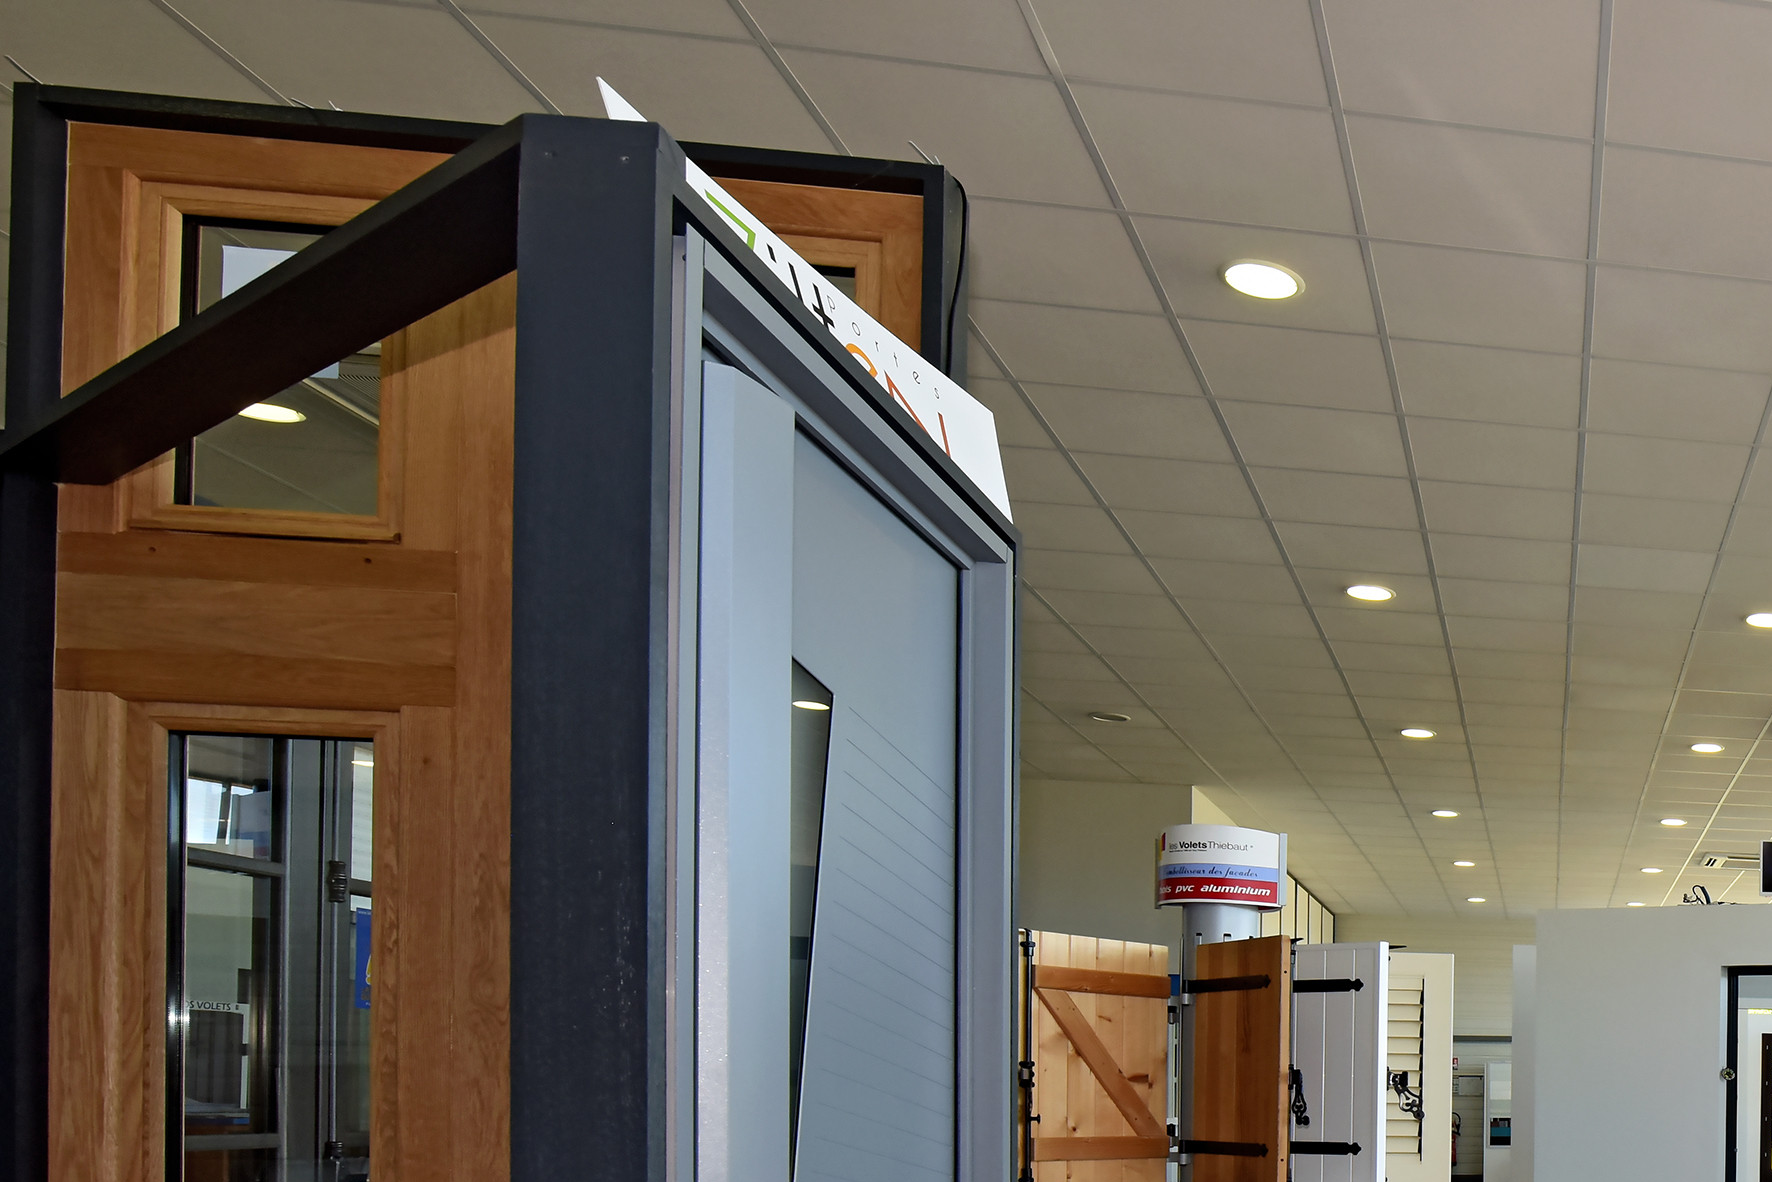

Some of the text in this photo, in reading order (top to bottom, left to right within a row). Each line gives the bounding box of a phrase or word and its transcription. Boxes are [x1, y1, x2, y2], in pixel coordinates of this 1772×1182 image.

[1175, 885, 1195, 894] pvc
[1201, 884, 1271, 896] aluminium
[196, 1001, 231, 1010] VOLETS
